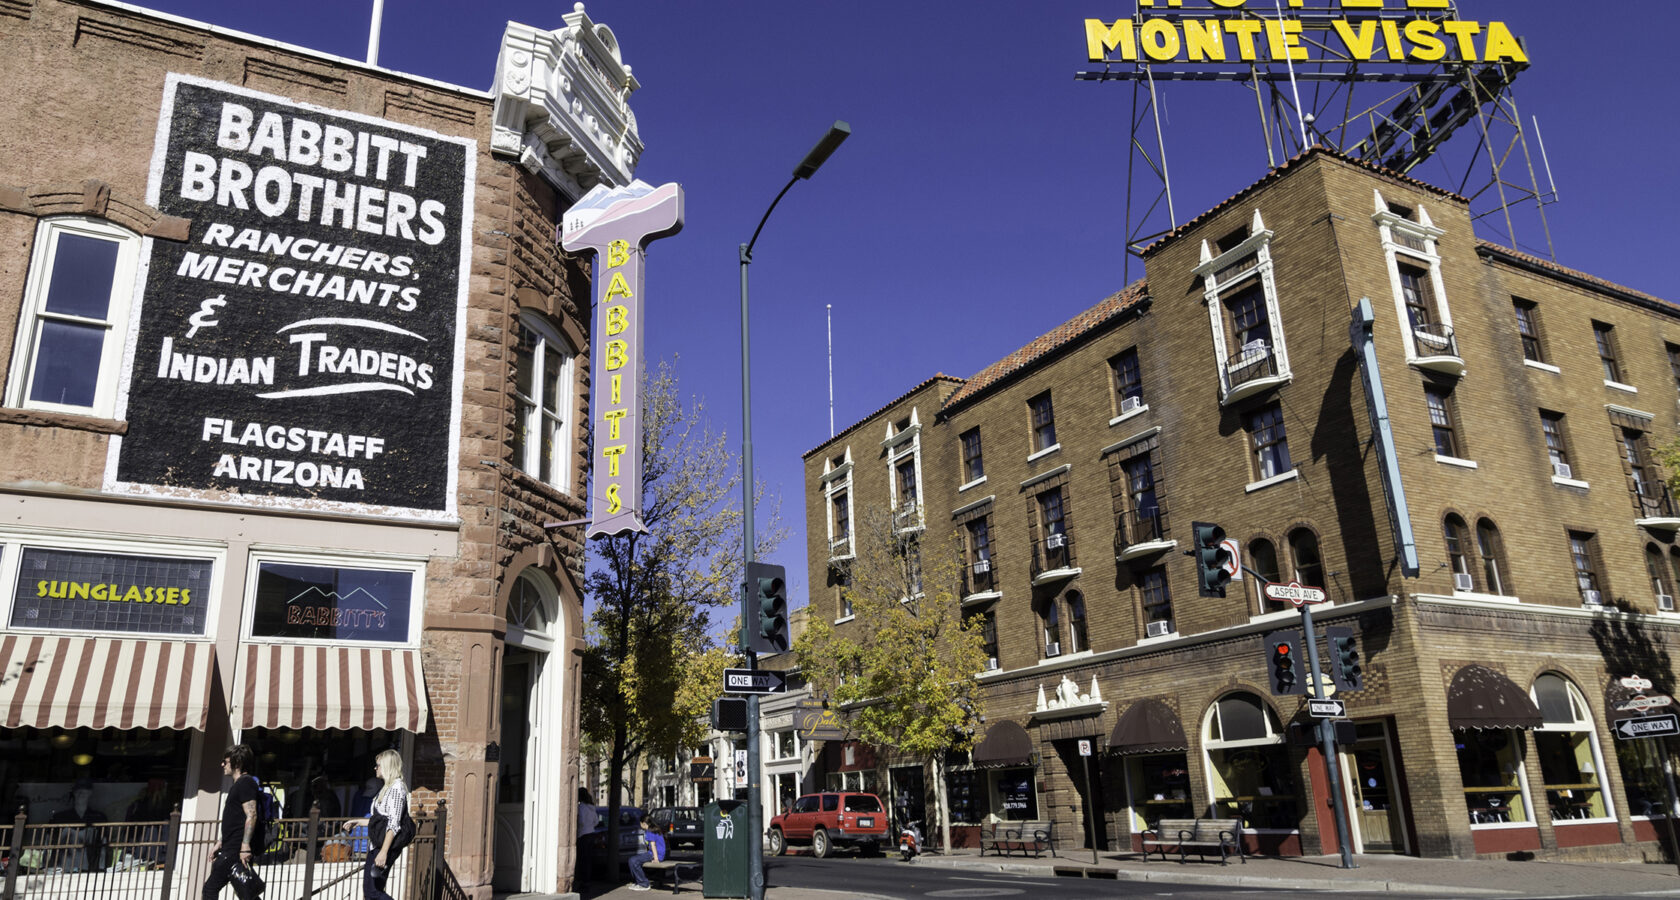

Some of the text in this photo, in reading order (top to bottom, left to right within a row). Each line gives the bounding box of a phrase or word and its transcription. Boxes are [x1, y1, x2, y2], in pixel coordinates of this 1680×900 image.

[1084, 18, 1528, 63] MONTE VISTA
[217, 102, 427, 187] BABBITT
[180, 151, 446, 245] BROTHERS
[202, 222, 420, 280] RANCHERS,
[177, 251, 420, 312] MERCHANTS
[185, 295, 227, 338] &
[157, 332, 434, 390] INDIAN TRADERS
[602, 239, 634, 515] BABBITTS
[202, 417, 385, 460] FLAGSTAFF
[213, 454, 365, 490] ARIZONA
[37, 579, 191, 606] SUNGLASSES
[1274, 587, 1319, 600] ASPEN AVE
[287, 605, 386, 629] BABBITT'S
[730, 675, 770, 686] ONE WAY
[1631, 720, 1670, 732] ONE WAY
